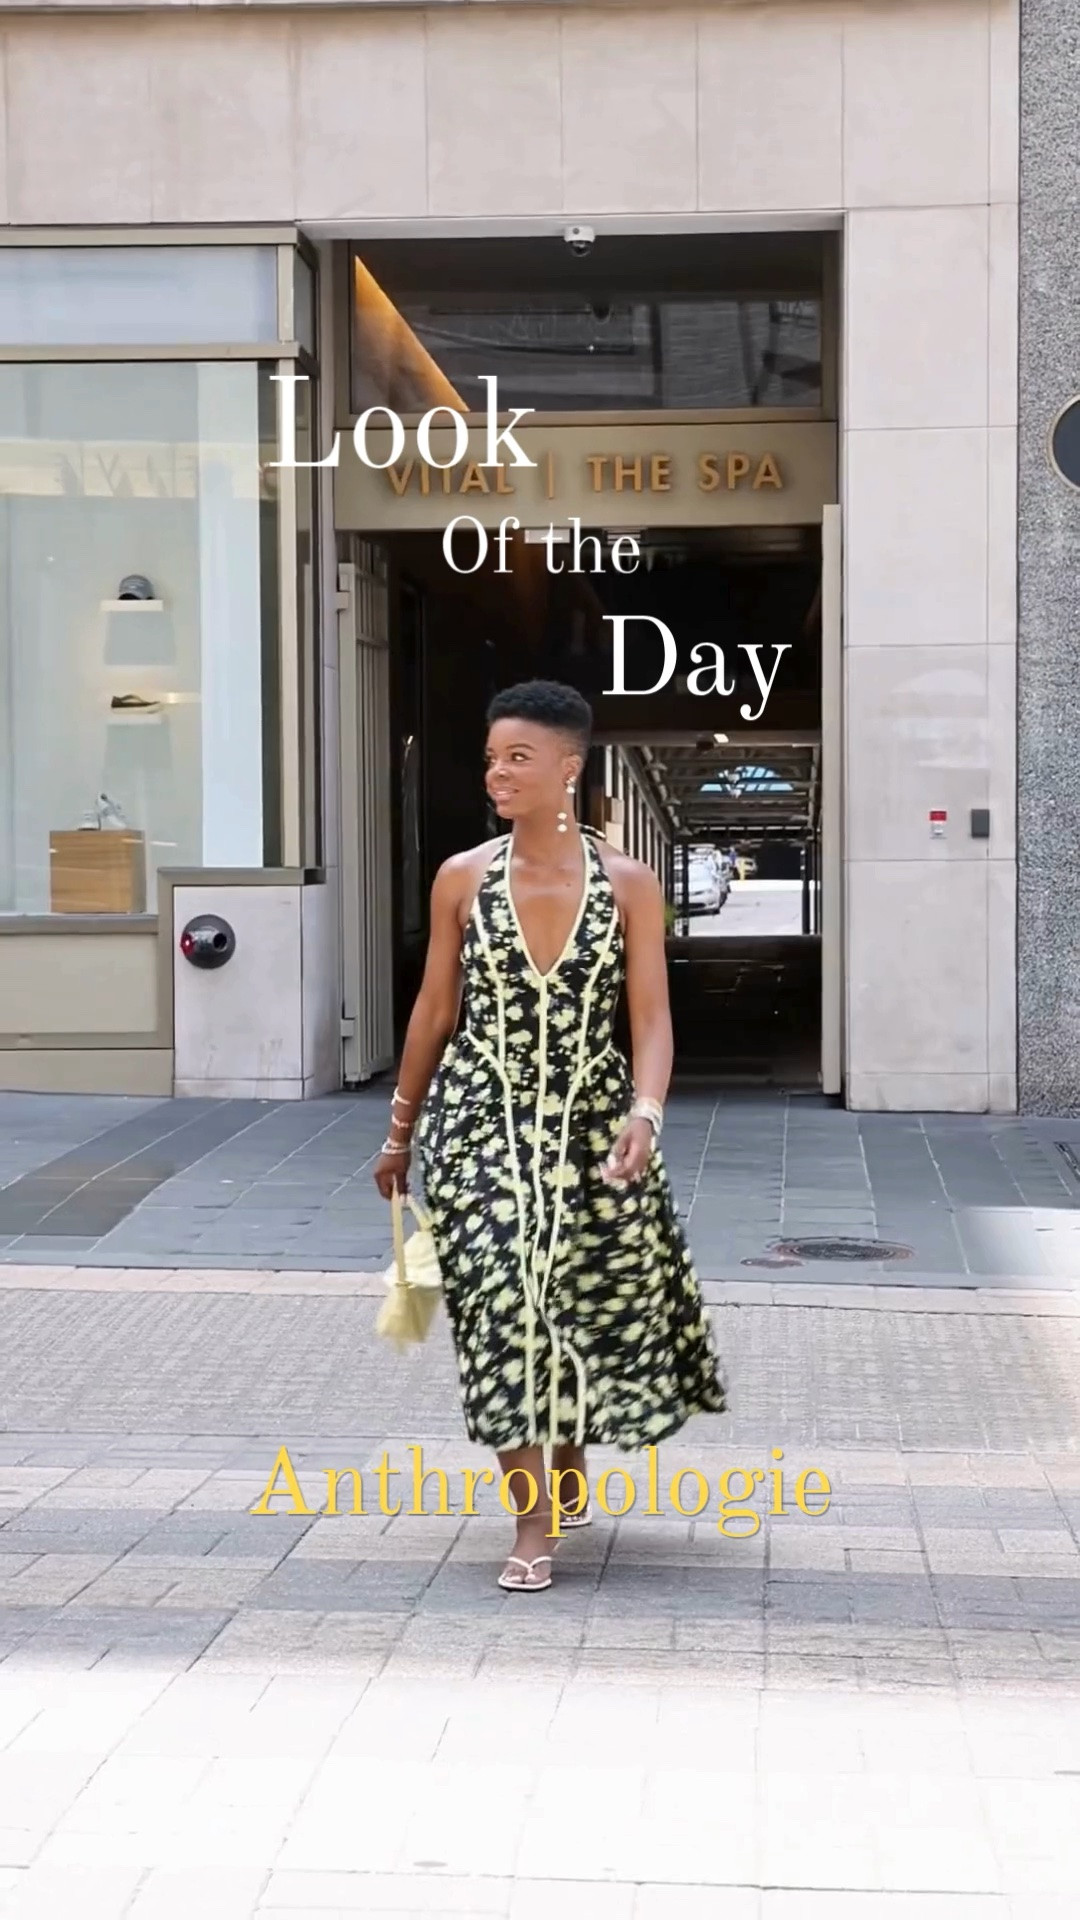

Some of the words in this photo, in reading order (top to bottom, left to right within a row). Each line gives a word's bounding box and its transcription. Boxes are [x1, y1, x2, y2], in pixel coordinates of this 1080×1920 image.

[384, 456, 515, 497] VITAL
[586, 454, 671, 493] THE
[698, 452, 783, 491] SPA
